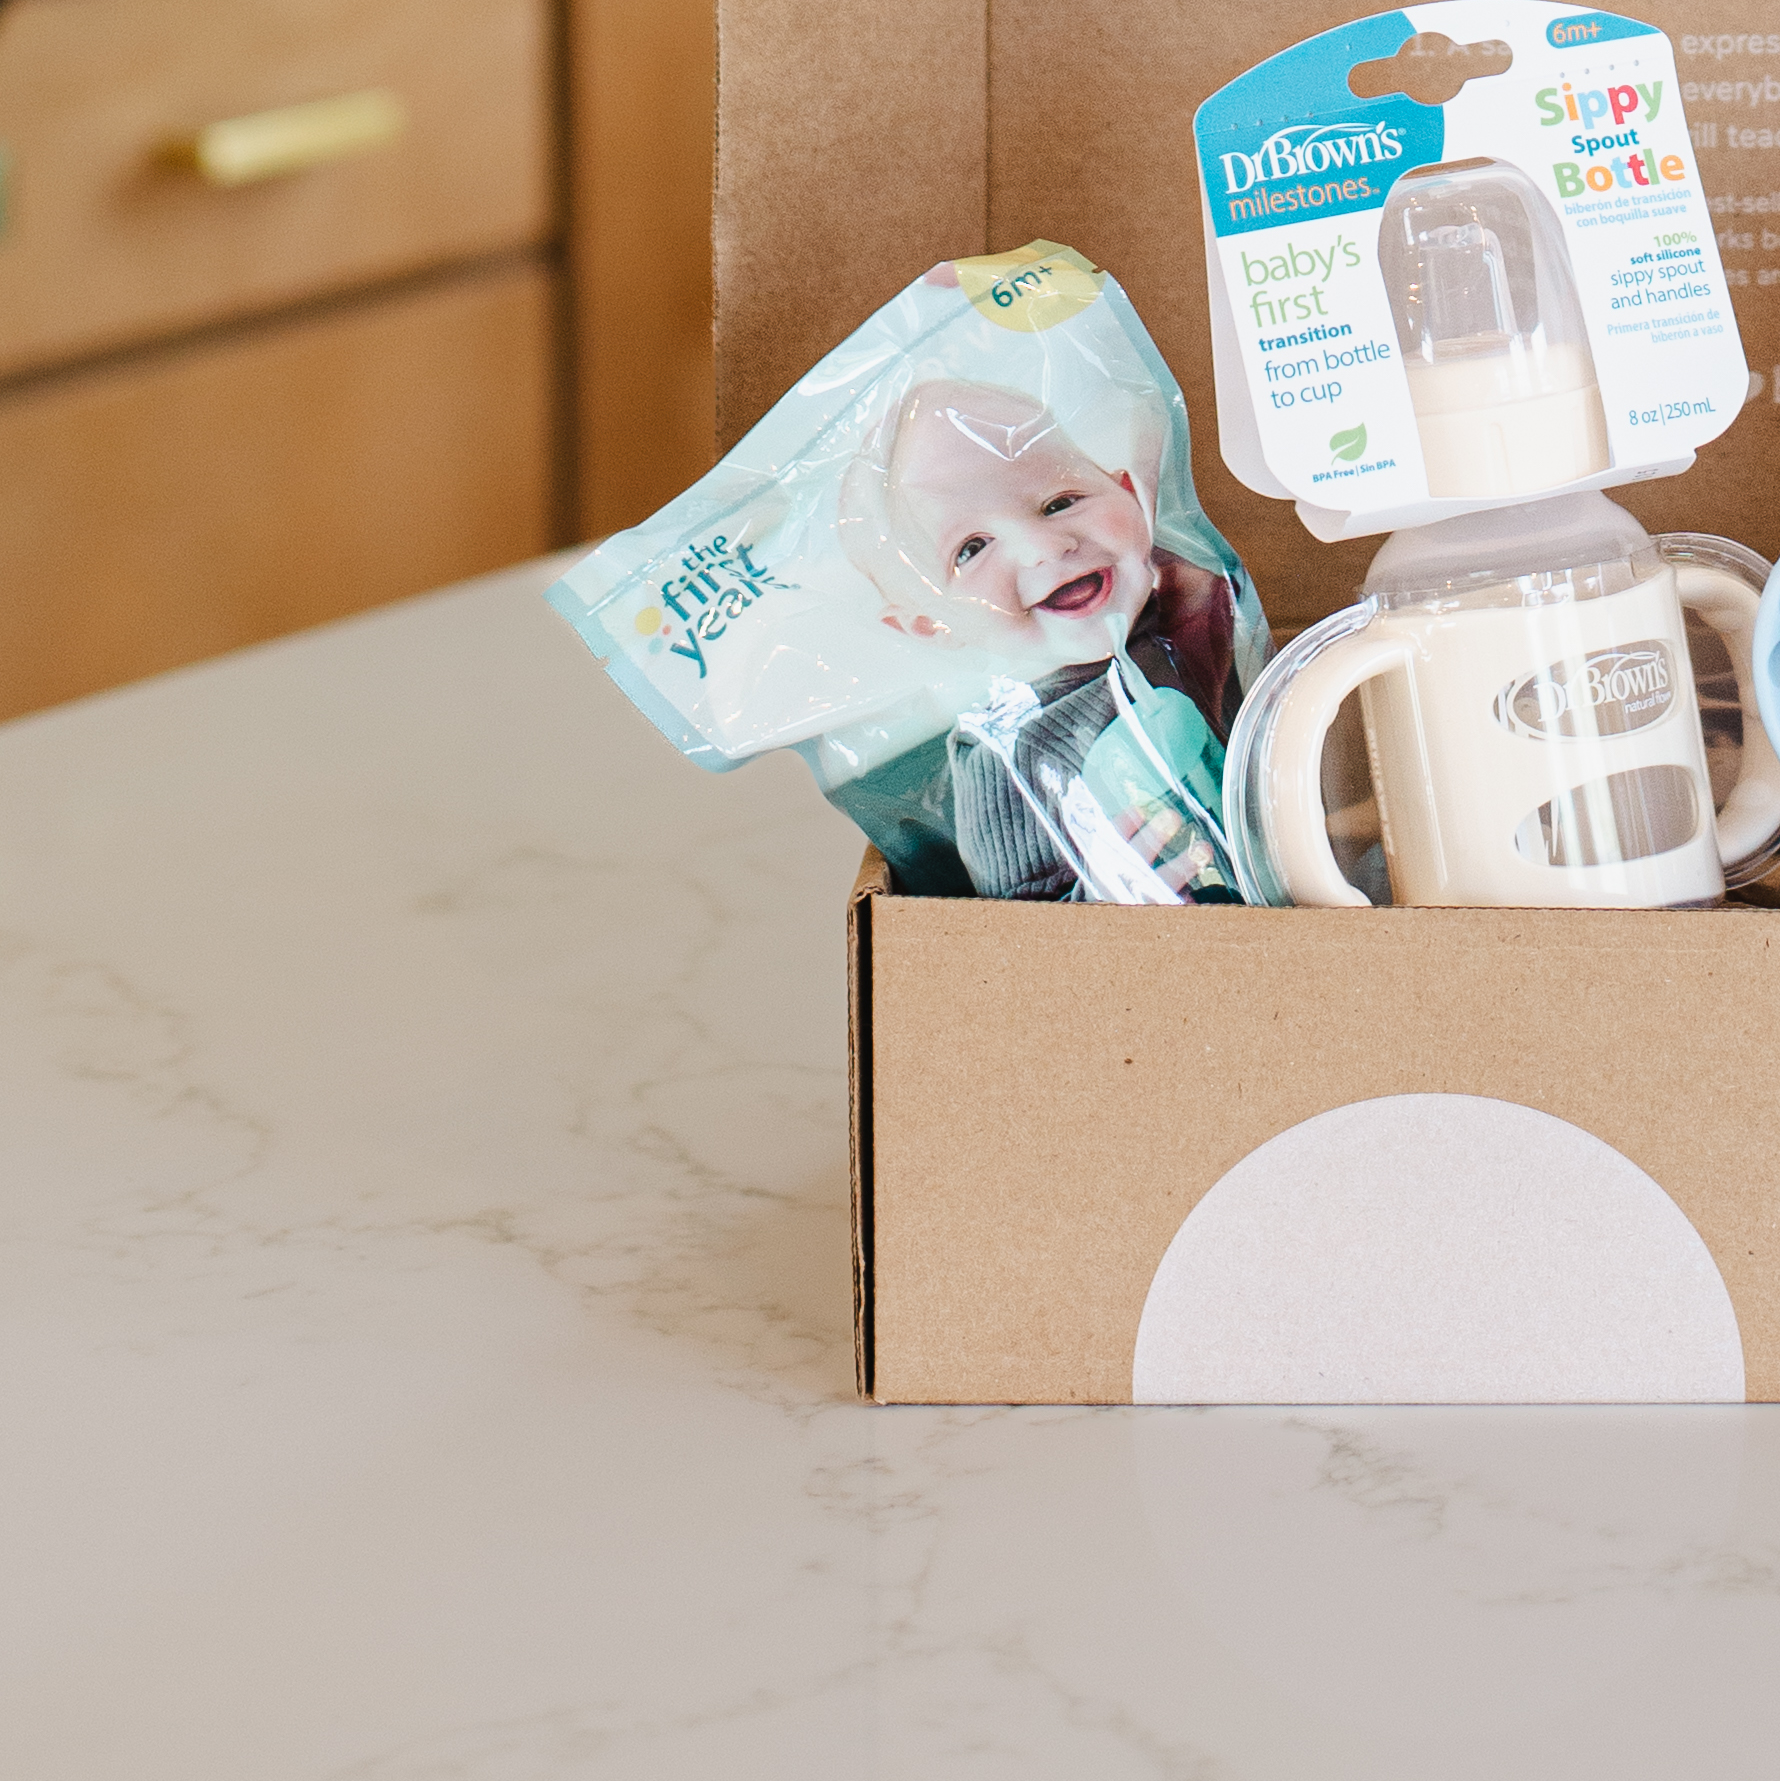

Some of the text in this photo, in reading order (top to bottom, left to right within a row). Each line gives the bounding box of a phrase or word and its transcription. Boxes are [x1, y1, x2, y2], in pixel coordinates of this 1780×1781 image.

[1553, 21, 1602, 44] 6m+
[1534, 80, 1664, 130] Sippy
[1571, 129, 1640, 157] Spout
[1691, 122, 1718, 148] ill
[1552, 148, 1686, 199] Bottle
[1229, 176, 1373, 221] milestones
[1564, 188, 1692, 216] biberón de transición
[1577, 204, 1687, 228] con boquilla suave
[1653, 231, 1698, 248] 100%
[1241, 235, 1361, 287] baby's
[1631, 247, 1702, 266] soft silicone
[992, 265, 1052, 308] 6m+
[1611, 260, 1706, 288] sippy spout
[1250, 285, 1329, 328] first
[1611, 281, 1711, 310] and handles
[1607, 308, 1720, 336] Primera transición de
[1651, 322, 1724, 344] biberón vaso
[1258, 323, 1353, 353] transition
[1264, 340, 1391, 383] from bottle
[1271, 381, 1343, 409] to cup
[1629, 410, 1639, 426] 8
[1693, 397, 1717, 415] mL
[1313, 459, 1397, 483] BPA Free Sin BPA
[681, 535, 728, 571] the
[1624, 694, 1654, 715] natural
